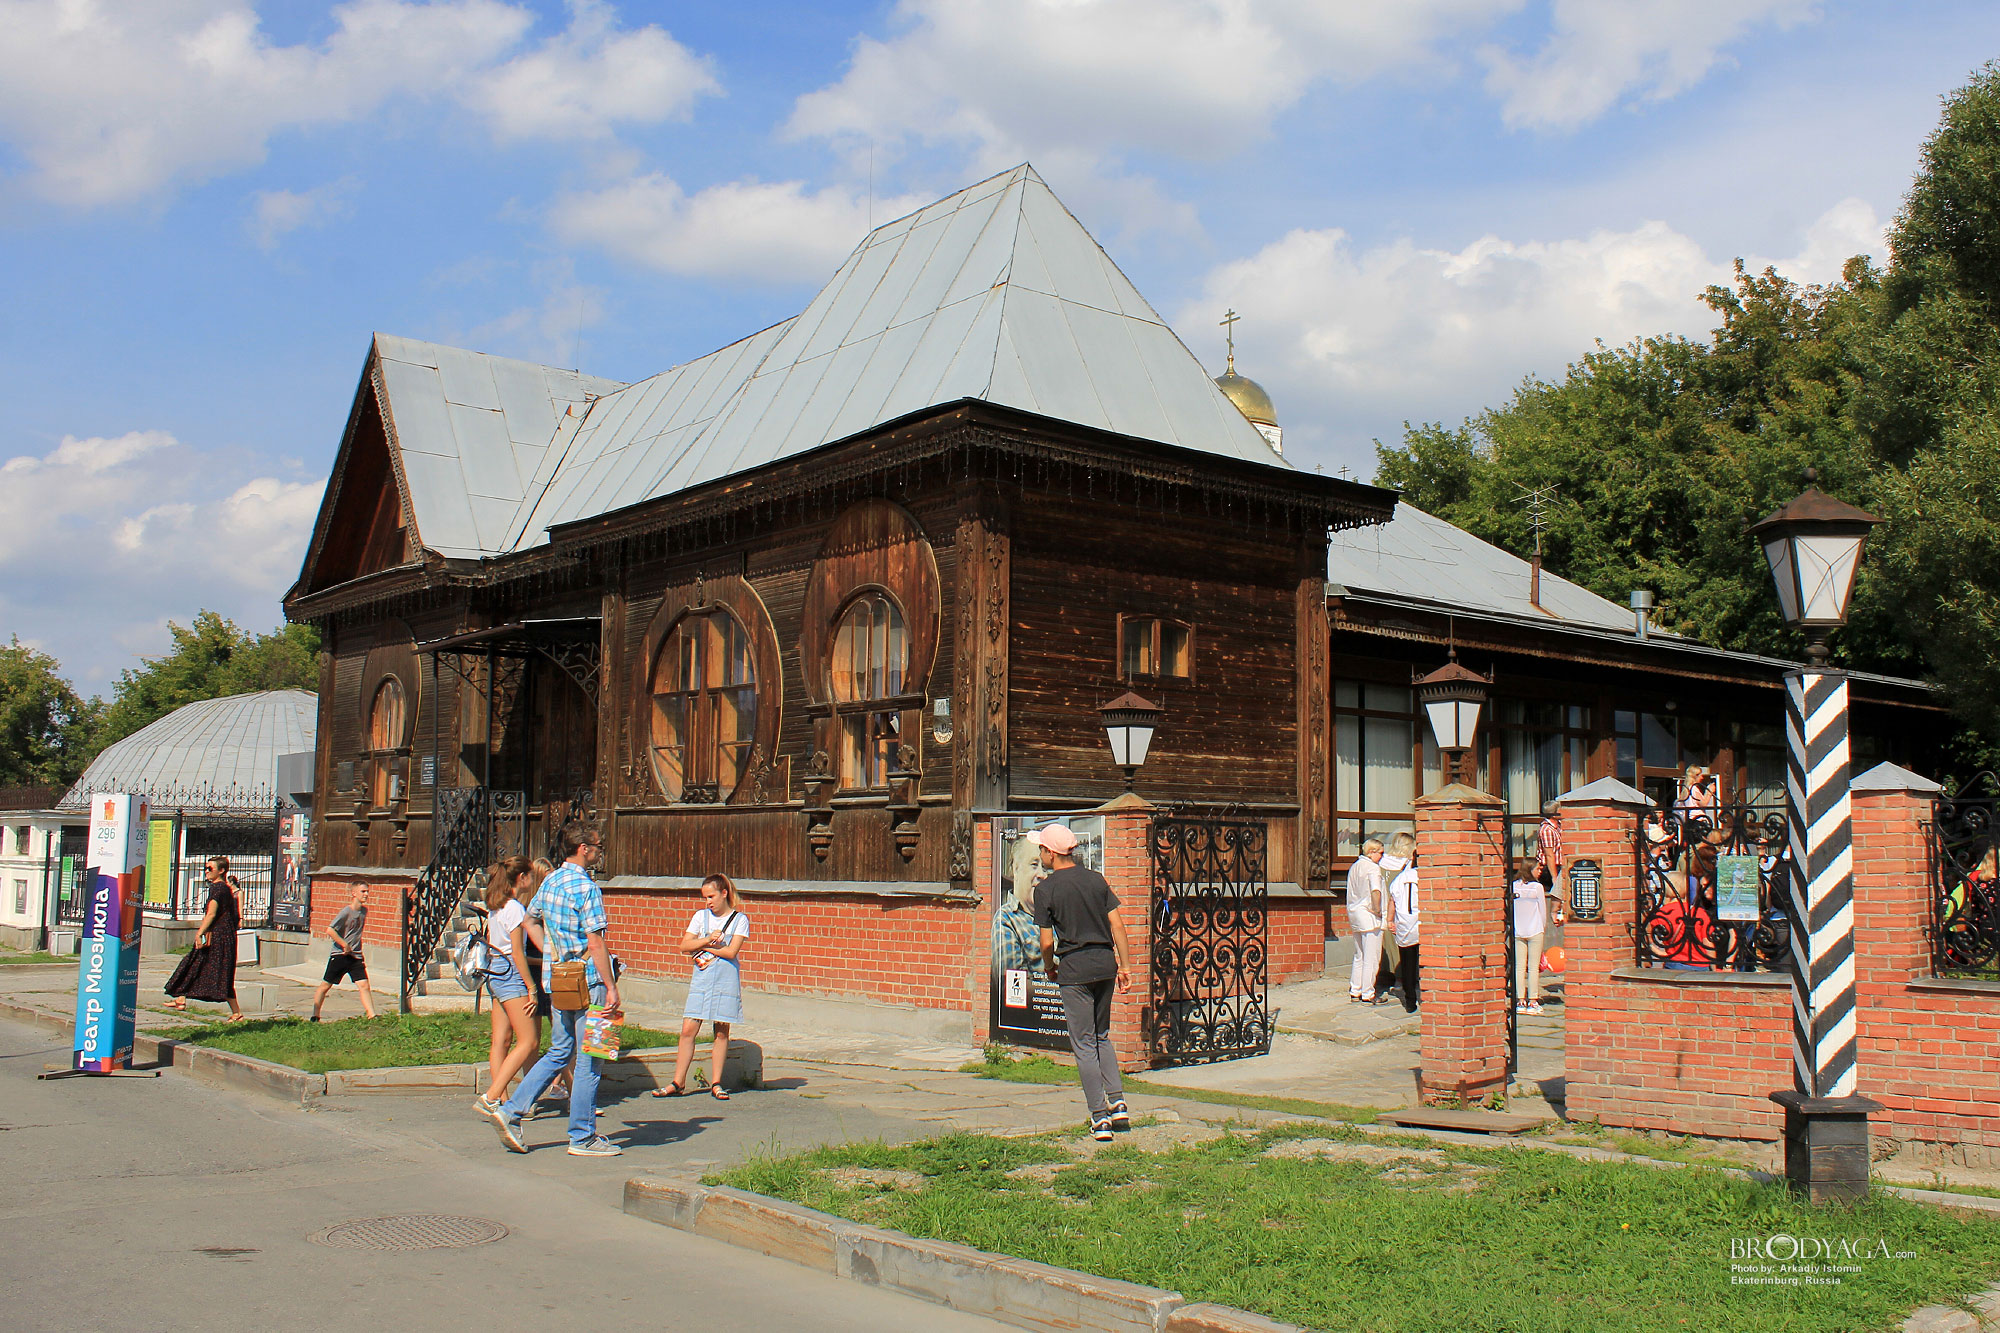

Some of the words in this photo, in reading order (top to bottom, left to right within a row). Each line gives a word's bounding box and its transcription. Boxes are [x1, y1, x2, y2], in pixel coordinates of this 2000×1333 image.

[97, 827, 116, 840] 296
[135, 829, 147, 841] 296
[85, 887, 110, 993] Мюзикла
[78, 998, 104, 1068] Театр
